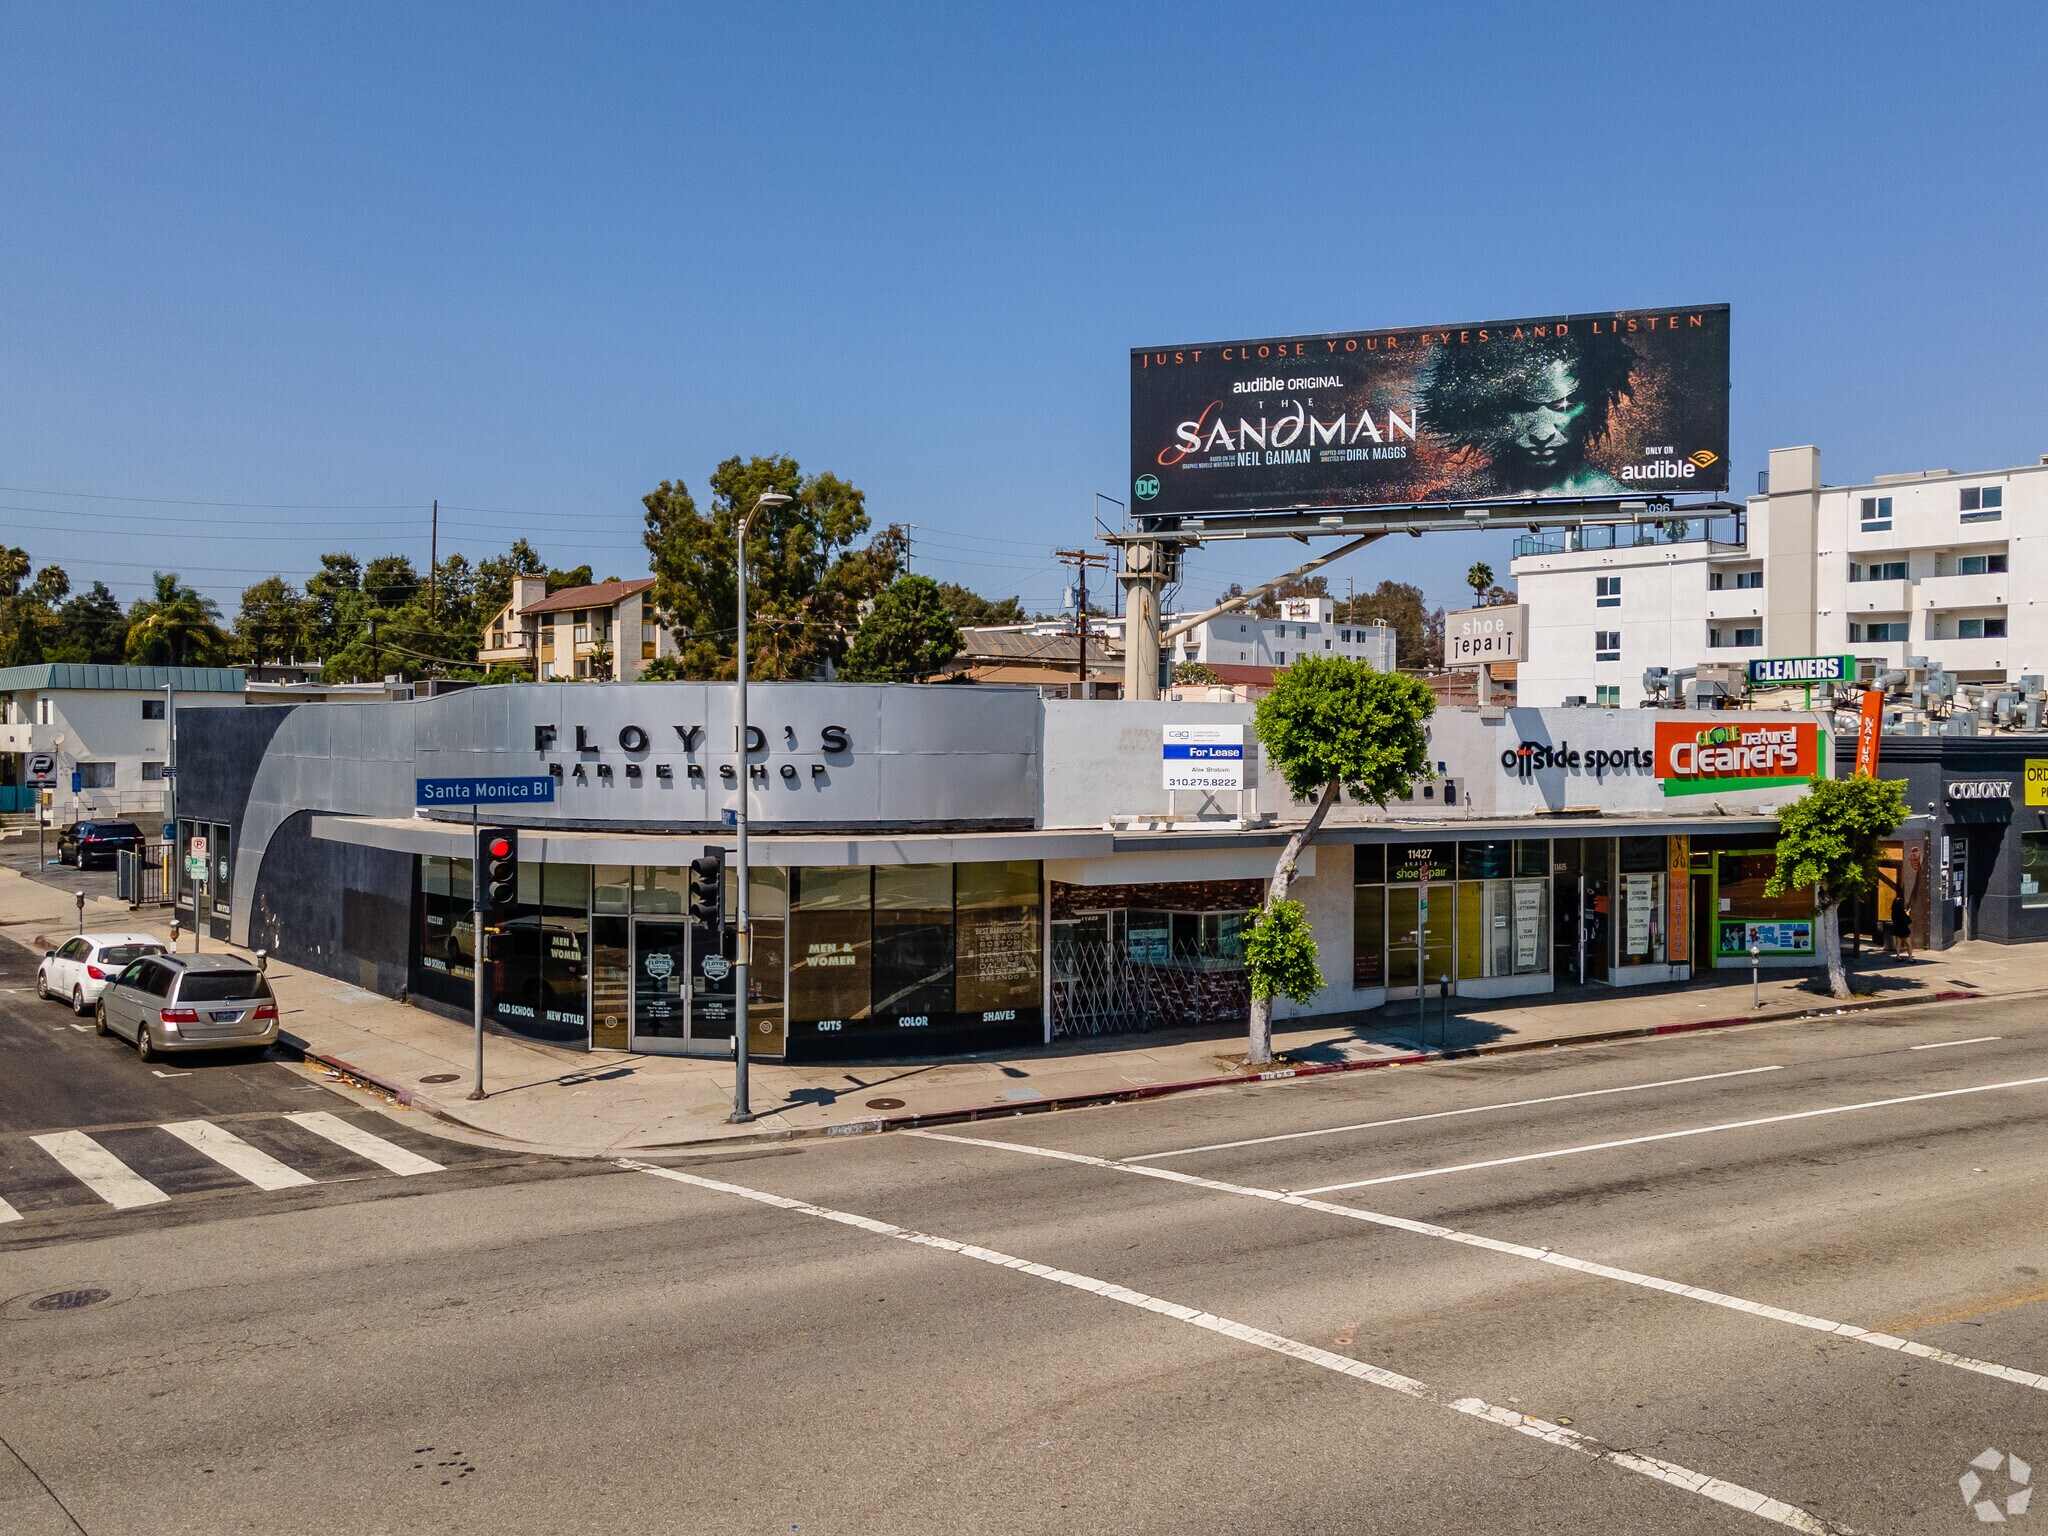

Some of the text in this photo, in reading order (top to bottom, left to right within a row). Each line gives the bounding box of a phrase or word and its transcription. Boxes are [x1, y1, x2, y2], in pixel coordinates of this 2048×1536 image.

[1143, 314, 1703, 368] JUST CLOSE YOUR EYES AND LISTEN
[1233, 375, 1344, 393] audible ORIGINAL
[1258, 397, 1314, 409] THE
[1175, 400, 1417, 453] SANDMAN
[1237, 449, 1311, 466] NEIL GAIMAN
[1346, 446, 1407, 461] DIRK MAGGS
[1645, 446, 1674, 455] ONLY ON
[1621, 459, 1696, 479] audible
[1136, 479, 1160, 494] DC
[1645, 503, 1670, 513] 096
[1463, 617, 1504, 635] shoe
[1755, 657, 1839, 681] CLEANERS
[534, 724, 848, 752] FLOYD'S
[1169, 731, 1189, 740] cag
[1696, 726, 1797, 746] GLOBE natural
[1190, 747, 1240, 757] For Lease
[1670, 742, 1798, 774] Cleaners
[1584, 747, 1654, 776] sports
[548, 763, 826, 779] BARBERSHOP
[1169, 778, 1237, 786] 310.275.8222
[424, 784, 470, 798] Santa
[475, 782, 528, 797] Monica
[1949, 781, 2012, 799] COLONY
[1408, 849, 1432, 859] 11427
[1396, 867, 1419, 879] shoe
[552, 936, 579, 948] MEN &
[808, 943, 854, 954] MEN &
[980, 940, 1020, 948] BOSTON
[550, 948, 582, 961] WOMEN
[806, 954, 856, 967] WOMEN
[980, 974, 1020, 982] ORLANDO
[498, 1003, 535, 1018] OLD SCHOOL
[546, 1010, 584, 1026] NEW STYLES
[983, 1009, 1016, 1023] SHAVES
[817, 1020, 842, 1032] CUTS
[899, 1016, 929, 1028] COLOR
